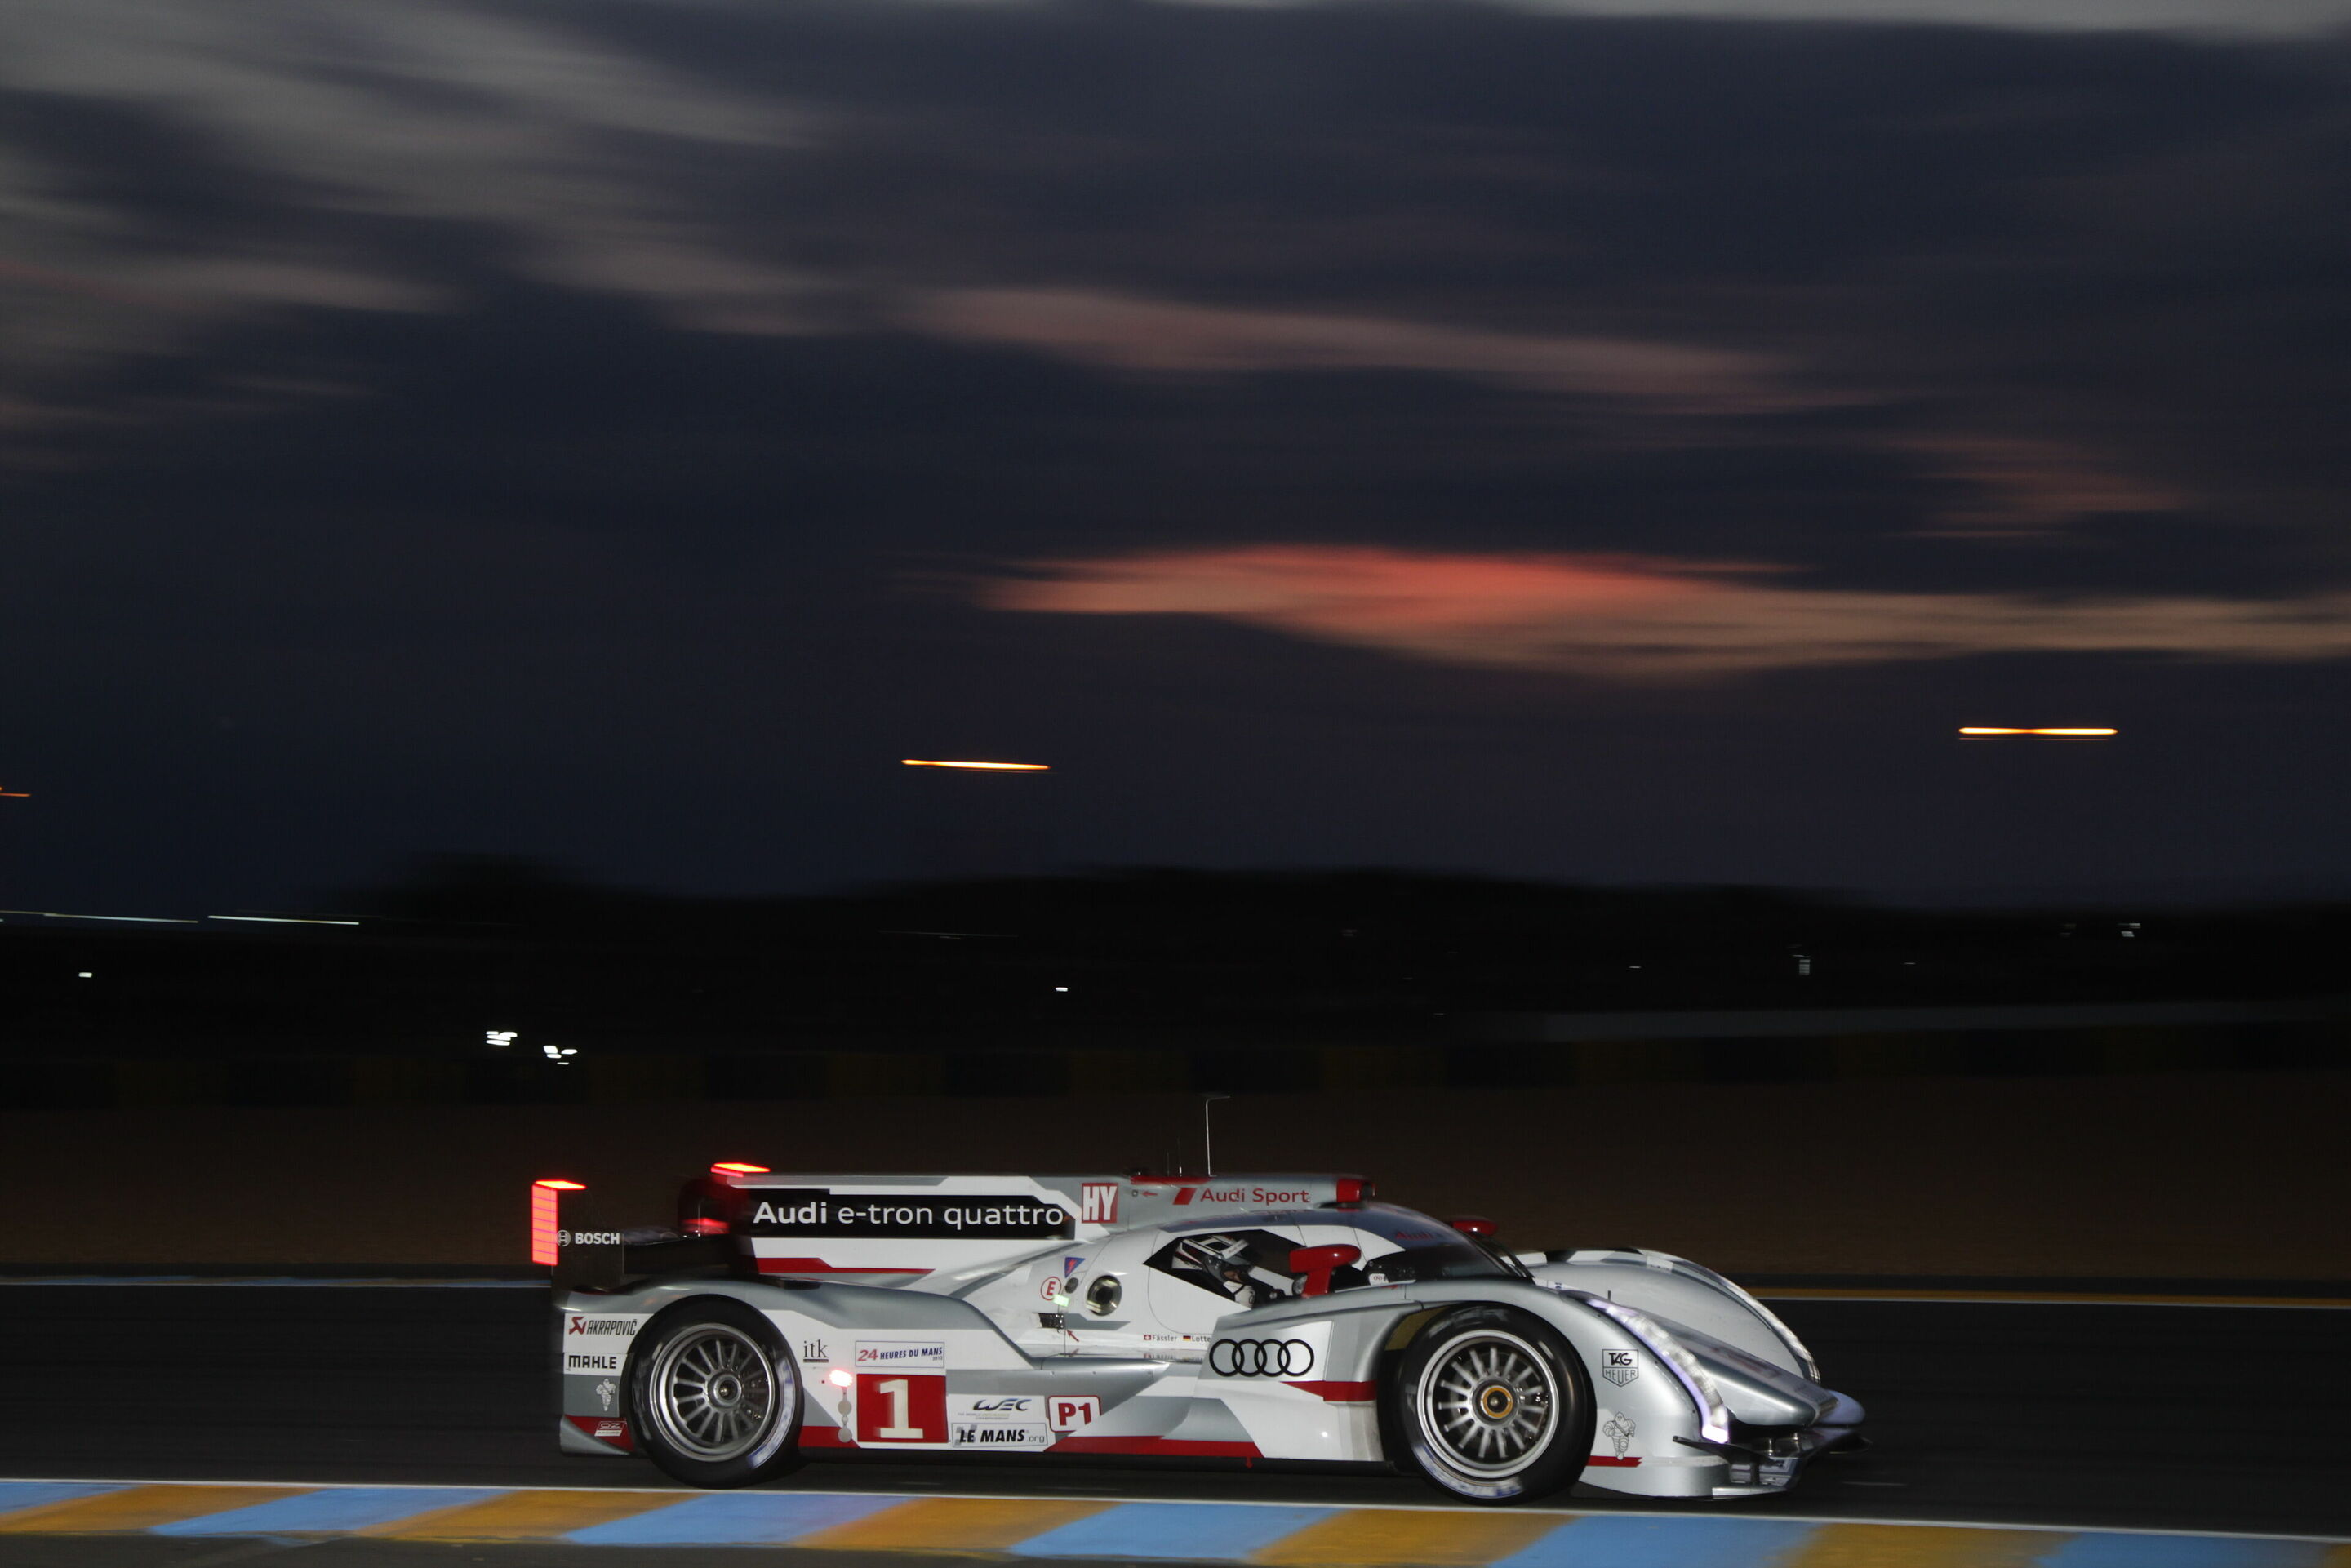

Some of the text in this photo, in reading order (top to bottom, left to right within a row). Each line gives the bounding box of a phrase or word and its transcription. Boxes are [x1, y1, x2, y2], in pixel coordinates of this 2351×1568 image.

[1082, 1185, 1118, 1221] HY
[1200, 1188, 1309, 1206] Audi Sport
[753, 1201, 1063, 1230] Audi e-tron quattro
[574, 1232, 620, 1245] BOSCH
[1046, 1281, 1056, 1296] E
[586, 1318, 638, 1336] AKRAPOVIČ
[802, 1338, 828, 1358] itk
[857, 1347, 943, 1362] 24 HEURES DU MANS
[568, 1355, 617, 1370] MAHLE
[1608, 1352, 1633, 1366] TAG
[1605, 1369, 1637, 1384] HEUER
[879, 1379, 924, 1439] 1
[972, 1397, 1033, 1411] WEC
[1057, 1402, 1092, 1427] P1
[959, 1429, 976, 1443] LE
[980, 1428, 1025, 1443] MANS
